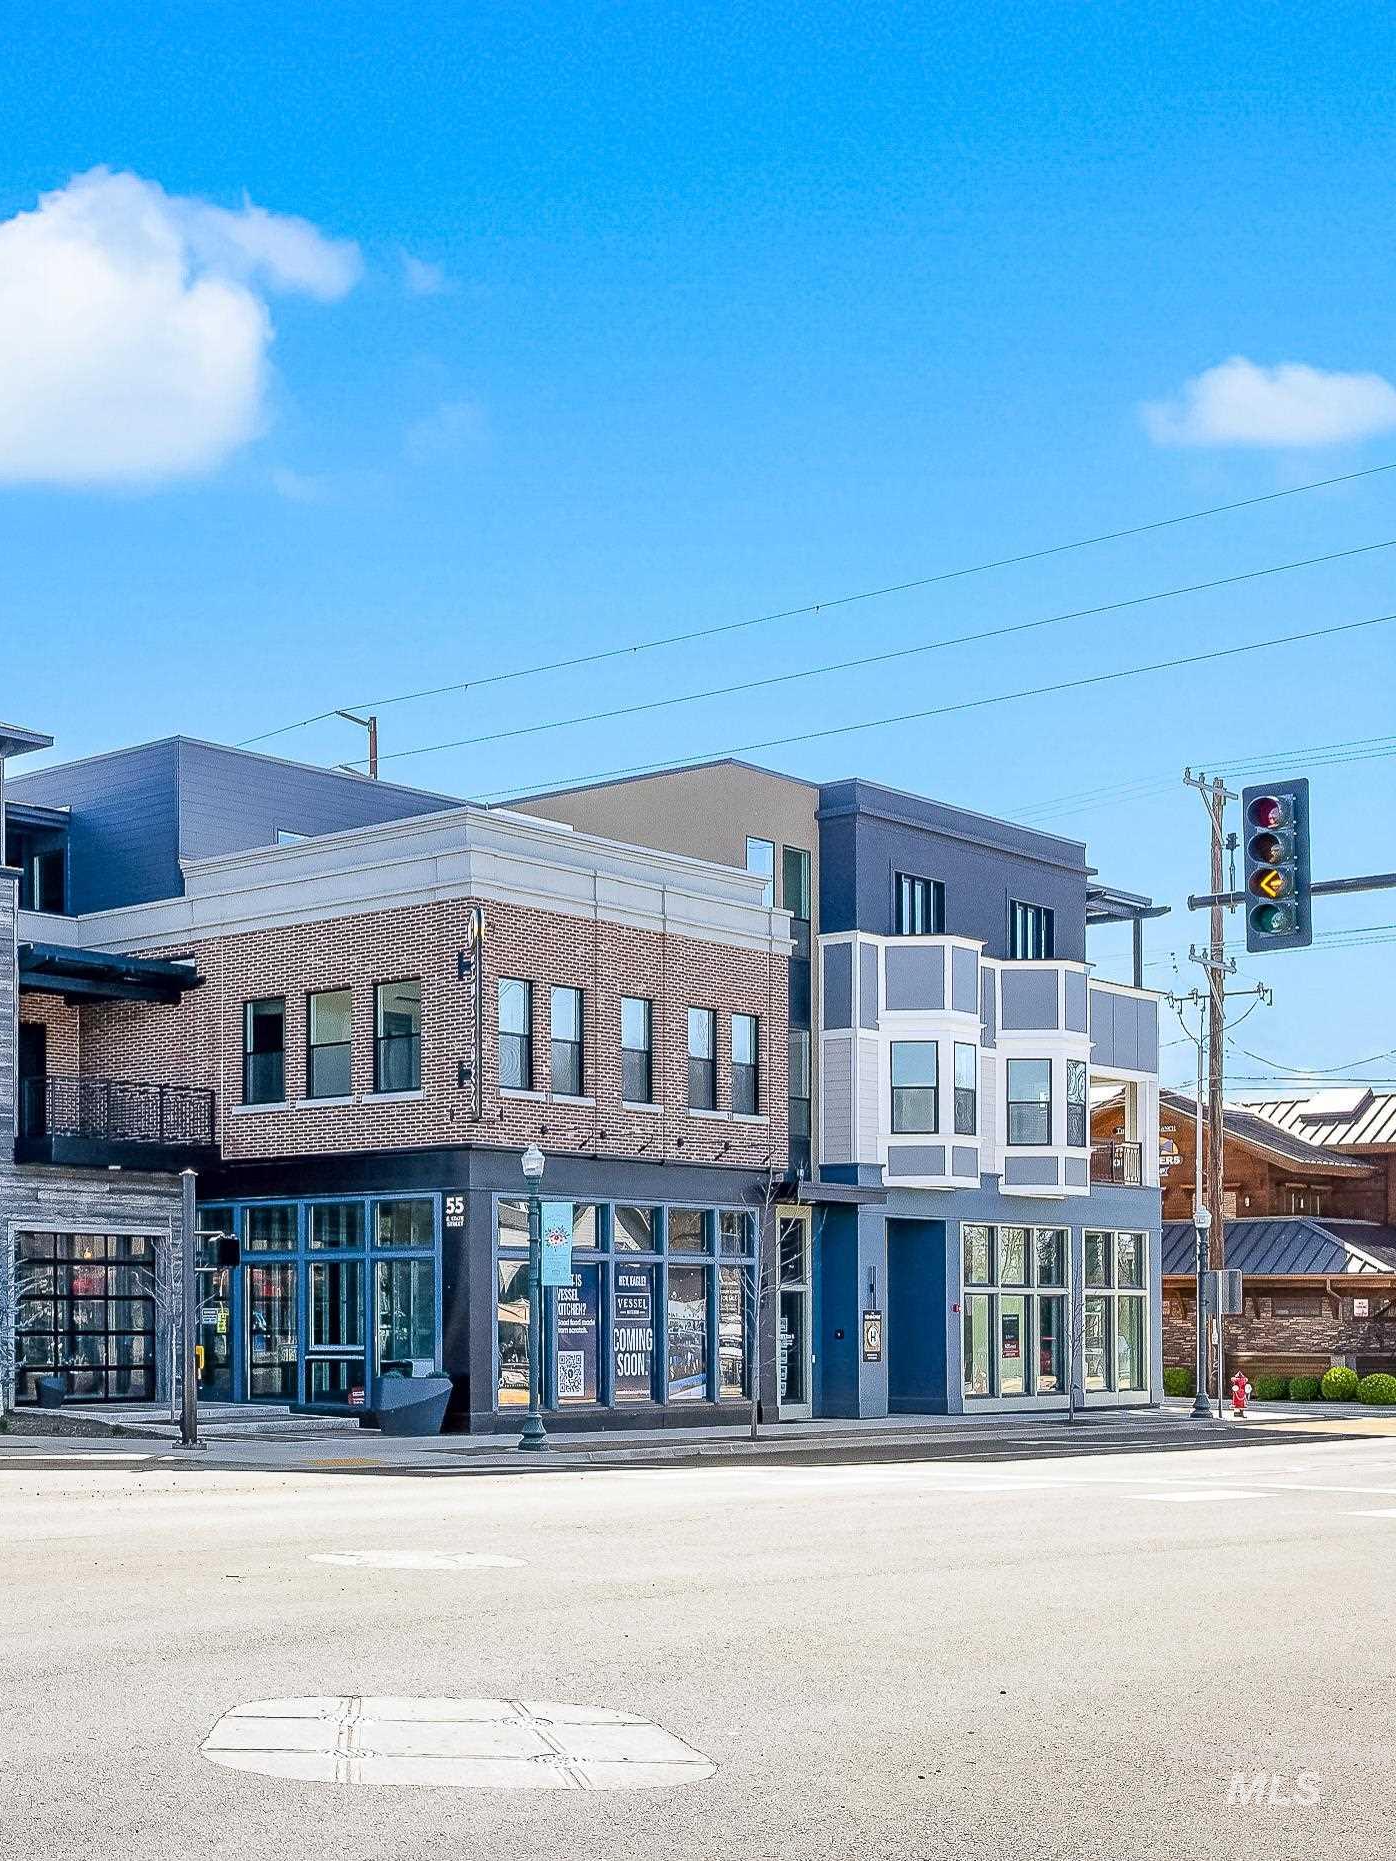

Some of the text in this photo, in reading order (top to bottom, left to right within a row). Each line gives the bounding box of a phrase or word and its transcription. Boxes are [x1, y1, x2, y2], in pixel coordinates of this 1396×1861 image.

[446, 1196, 464, 1214] 55
[557, 1288, 579, 1301] VESSEL
[617, 1298, 648, 1310] VESSEL
[613, 1328, 653, 1351] COMING
[616, 1352, 649, 1377] SOON.
